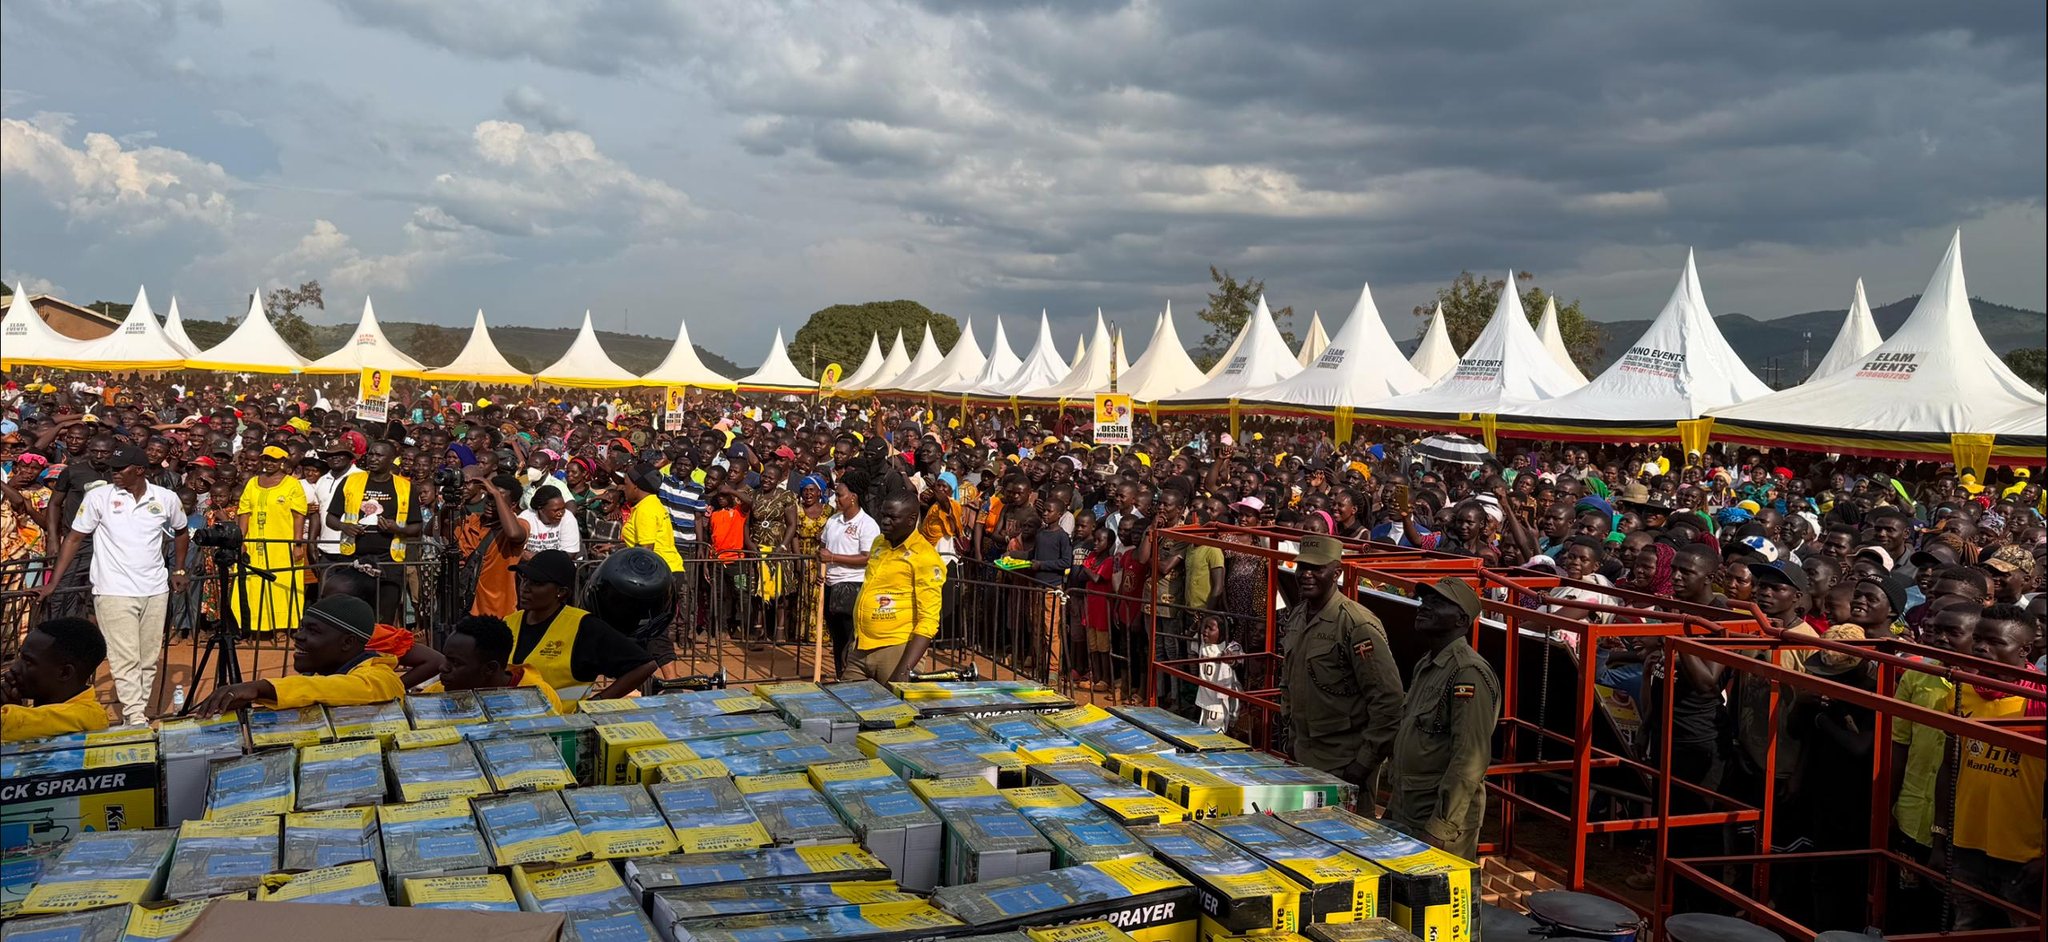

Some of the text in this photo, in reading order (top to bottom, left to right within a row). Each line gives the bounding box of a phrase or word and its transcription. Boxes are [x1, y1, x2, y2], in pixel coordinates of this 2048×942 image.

[1321, 355, 1345, 363] EVENTS
[1651, 349, 1686, 362] EVENTS
[1874, 353, 1916, 362] ELAM
[1476, 359, 1503, 367] EVENTS
[1861, 362, 1918, 373] EVENTS
[1101, 425, 1128, 433] DESIRE
[1203, 663, 1213, 676] 10
[1966, 758, 2019, 778] ManBetX
[1, 773, 127, 800] CK SPRAYER
[563, 865, 595, 874] litre
[1452, 886, 1460, 939] 16 litre
[1276, 907, 1285, 931] tre
[1073, 924, 1102, 935] litre
